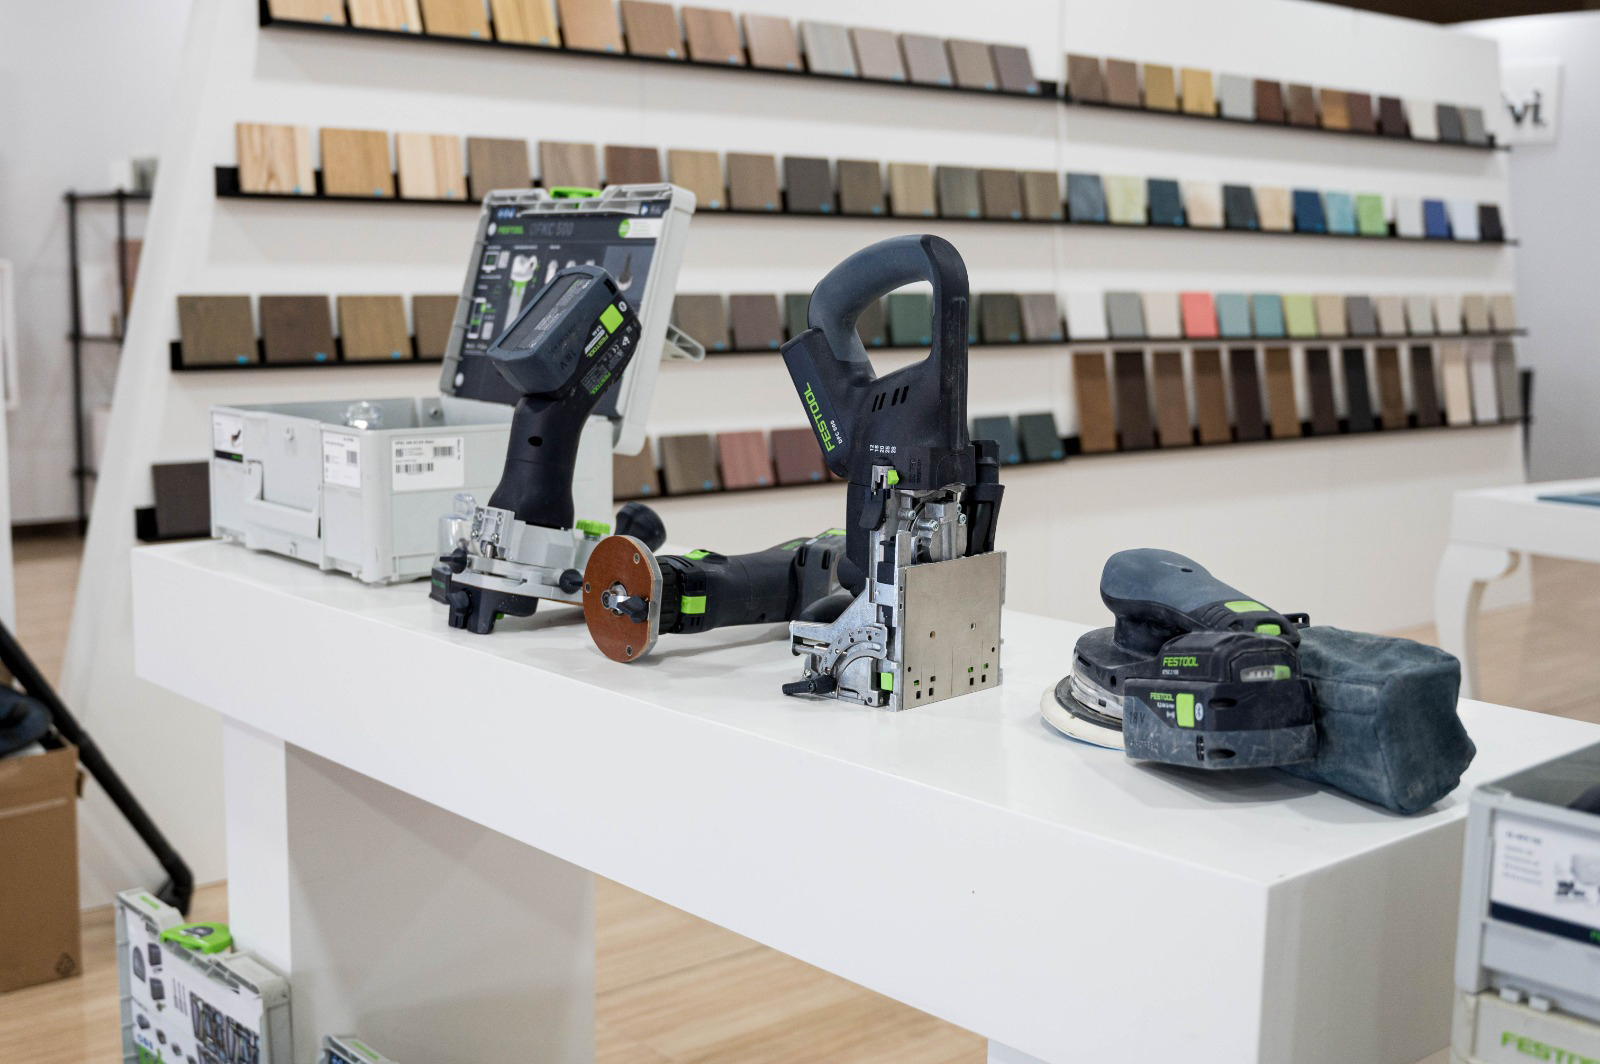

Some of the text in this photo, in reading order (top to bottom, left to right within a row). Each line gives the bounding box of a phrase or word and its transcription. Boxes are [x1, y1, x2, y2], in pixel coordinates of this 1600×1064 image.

[804, 382, 835, 452] FESTOOL
[870, 444, 875, 452] 12
[880, 445, 885, 453] 20
[1163, 656, 1198, 667] FESTOOL
[1150, 692, 1174, 701] FESTOOL
[1139, 711, 1146, 723] V
